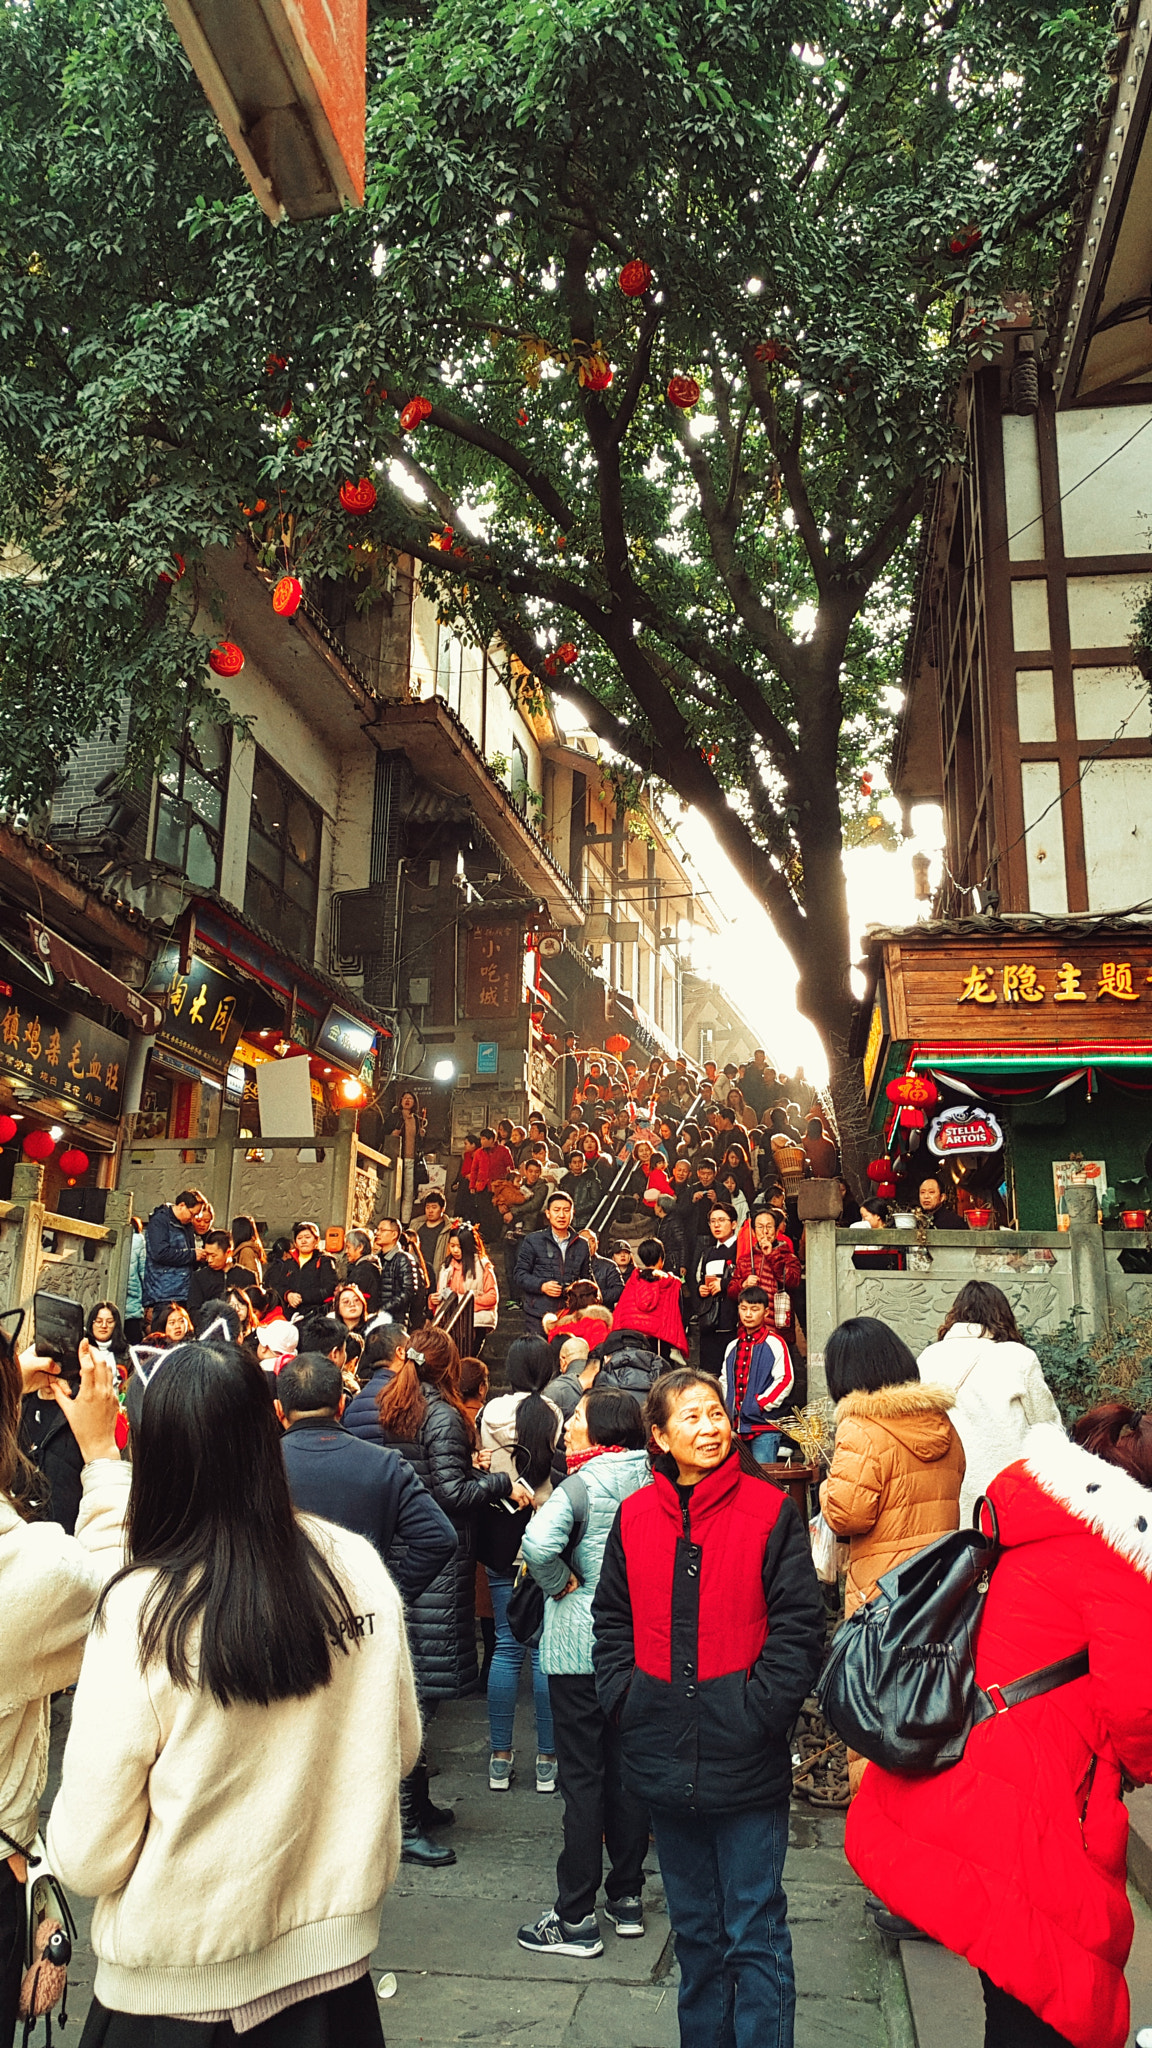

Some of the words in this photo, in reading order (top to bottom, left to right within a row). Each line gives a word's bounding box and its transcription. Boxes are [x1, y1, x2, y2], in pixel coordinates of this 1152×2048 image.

[480, 940, 500, 1007] 小吃城
[957, 962, 1152, 1003] 龙隐主题
[0, 1050, 34, 1076] 素炒菜
[897, 1078, 929, 1102] 福
[945, 1125, 985, 1136] STELLA
[946, 1133, 987, 1144] ARTOIS
[544, 1926, 564, 1945] N
